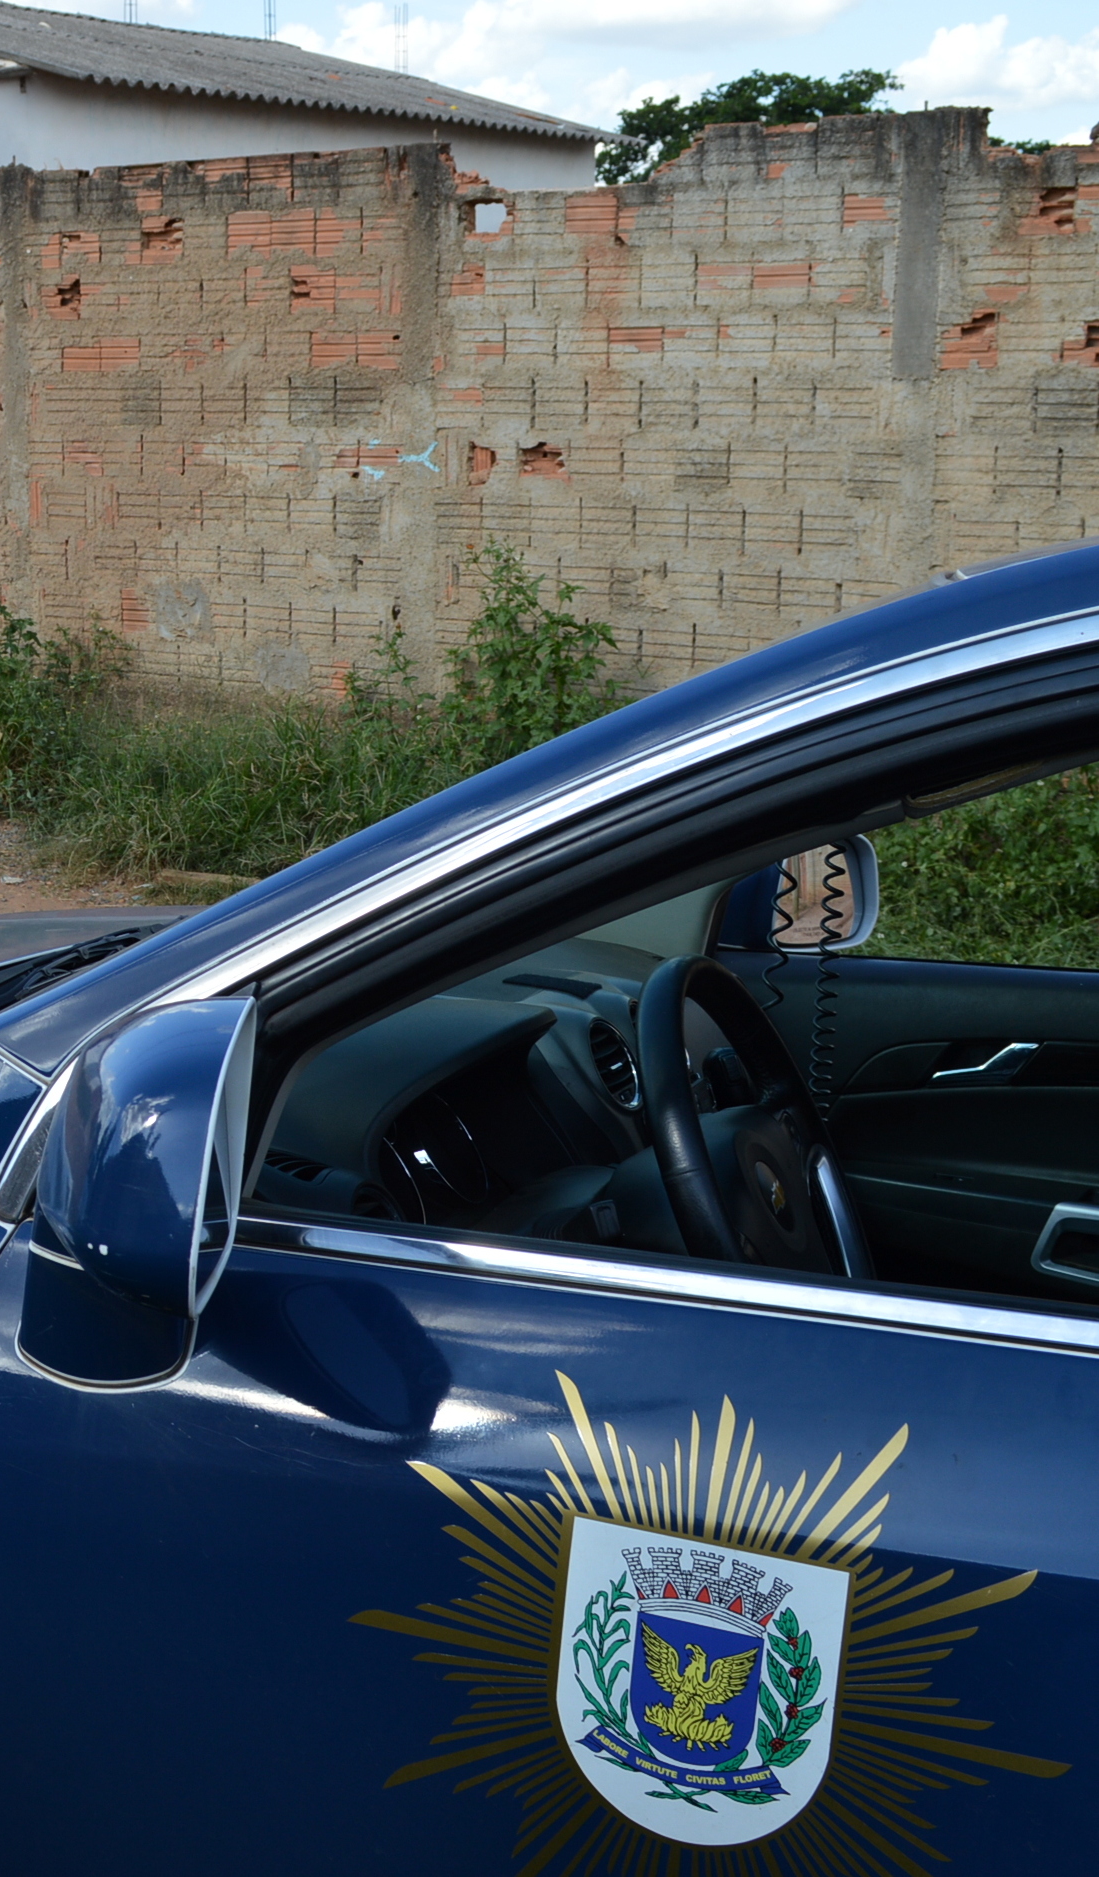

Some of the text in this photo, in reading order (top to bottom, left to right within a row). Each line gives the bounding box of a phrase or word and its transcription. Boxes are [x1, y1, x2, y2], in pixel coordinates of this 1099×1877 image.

[592, 1729, 771, 1785] LABORE VIRTUTE CIVITAS FLORET
